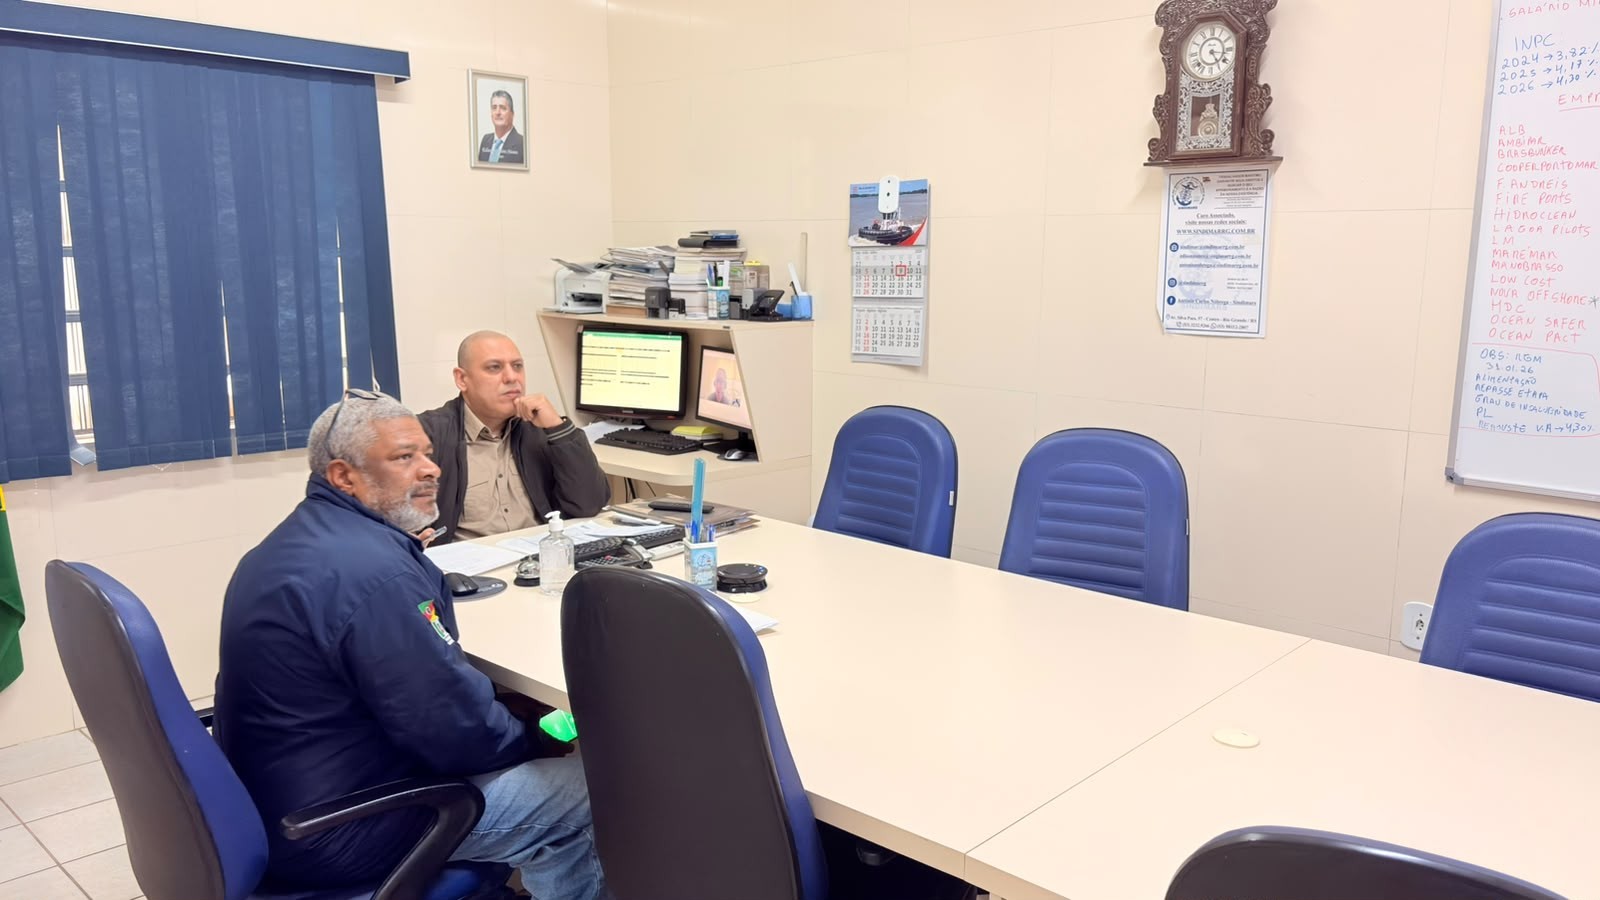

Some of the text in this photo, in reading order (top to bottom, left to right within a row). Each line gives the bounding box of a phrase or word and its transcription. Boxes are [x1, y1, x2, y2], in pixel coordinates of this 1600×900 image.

[1514, 34, 1555, 52] INPC
[1502, 53, 1540, 69] 2024
[1500, 69, 1536, 82] 2025
[1498, 80, 1534, 95] 2026
[1500, 124, 1526, 135] ALB
[1498, 145, 1566, 159] BRASBUNKER
[1497, 160, 1598, 172] COOPERPORTOMAR
[1494, 207, 1576, 221] HIDROCLEAN
[1493, 224, 1542, 233] LAGOA
[1490, 274, 1556, 287] LOW COST
[1490, 288, 1518, 298] NOVA
[1490, 314, 1586, 330] OCEAN SAFER
[1488, 328, 1582, 344] OCEAN PACT
[1480, 348, 1510, 360] OBS:
[1475, 394, 1500, 406] GRAU
[1518, 389, 1548, 400] ETAPA
[1476, 406, 1493, 418] PL
